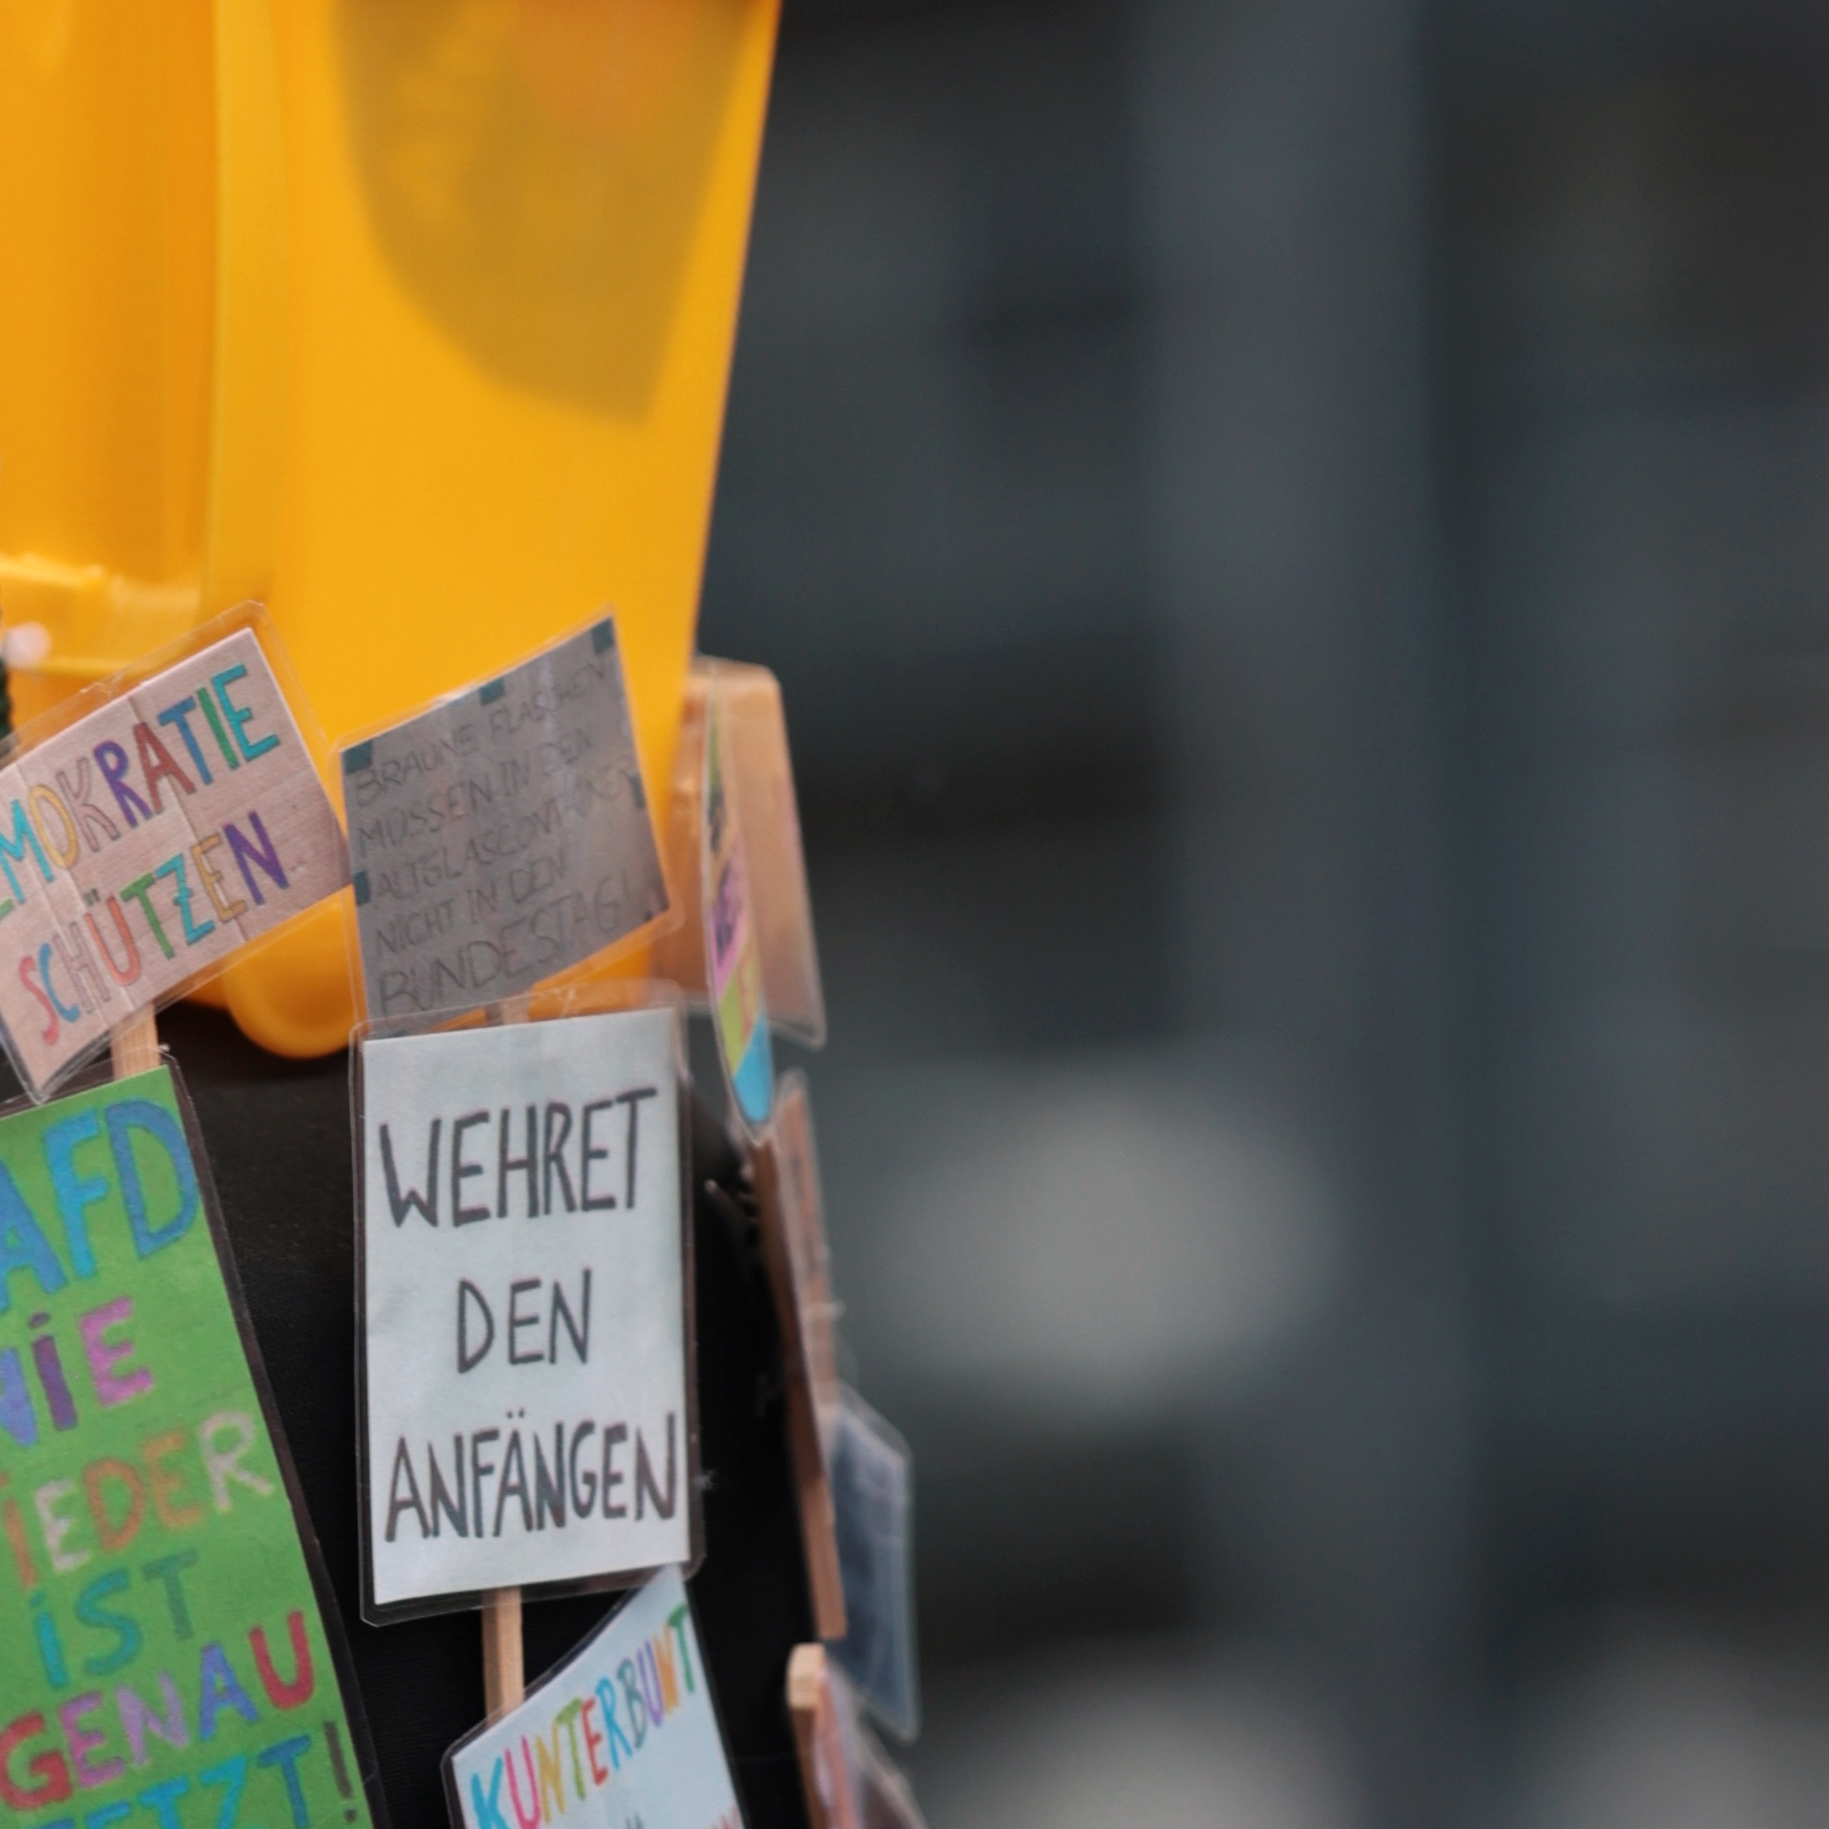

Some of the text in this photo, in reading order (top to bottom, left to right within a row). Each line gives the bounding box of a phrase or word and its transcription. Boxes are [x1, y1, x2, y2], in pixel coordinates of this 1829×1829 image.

[18, 811, 290, 1047] SCHÜTZEN
[379, 1088, 658, 1228] WEHRET
[457, 1268, 592, 1375] DEN
[385, 1408, 677, 1544] ANFÄNGEN
